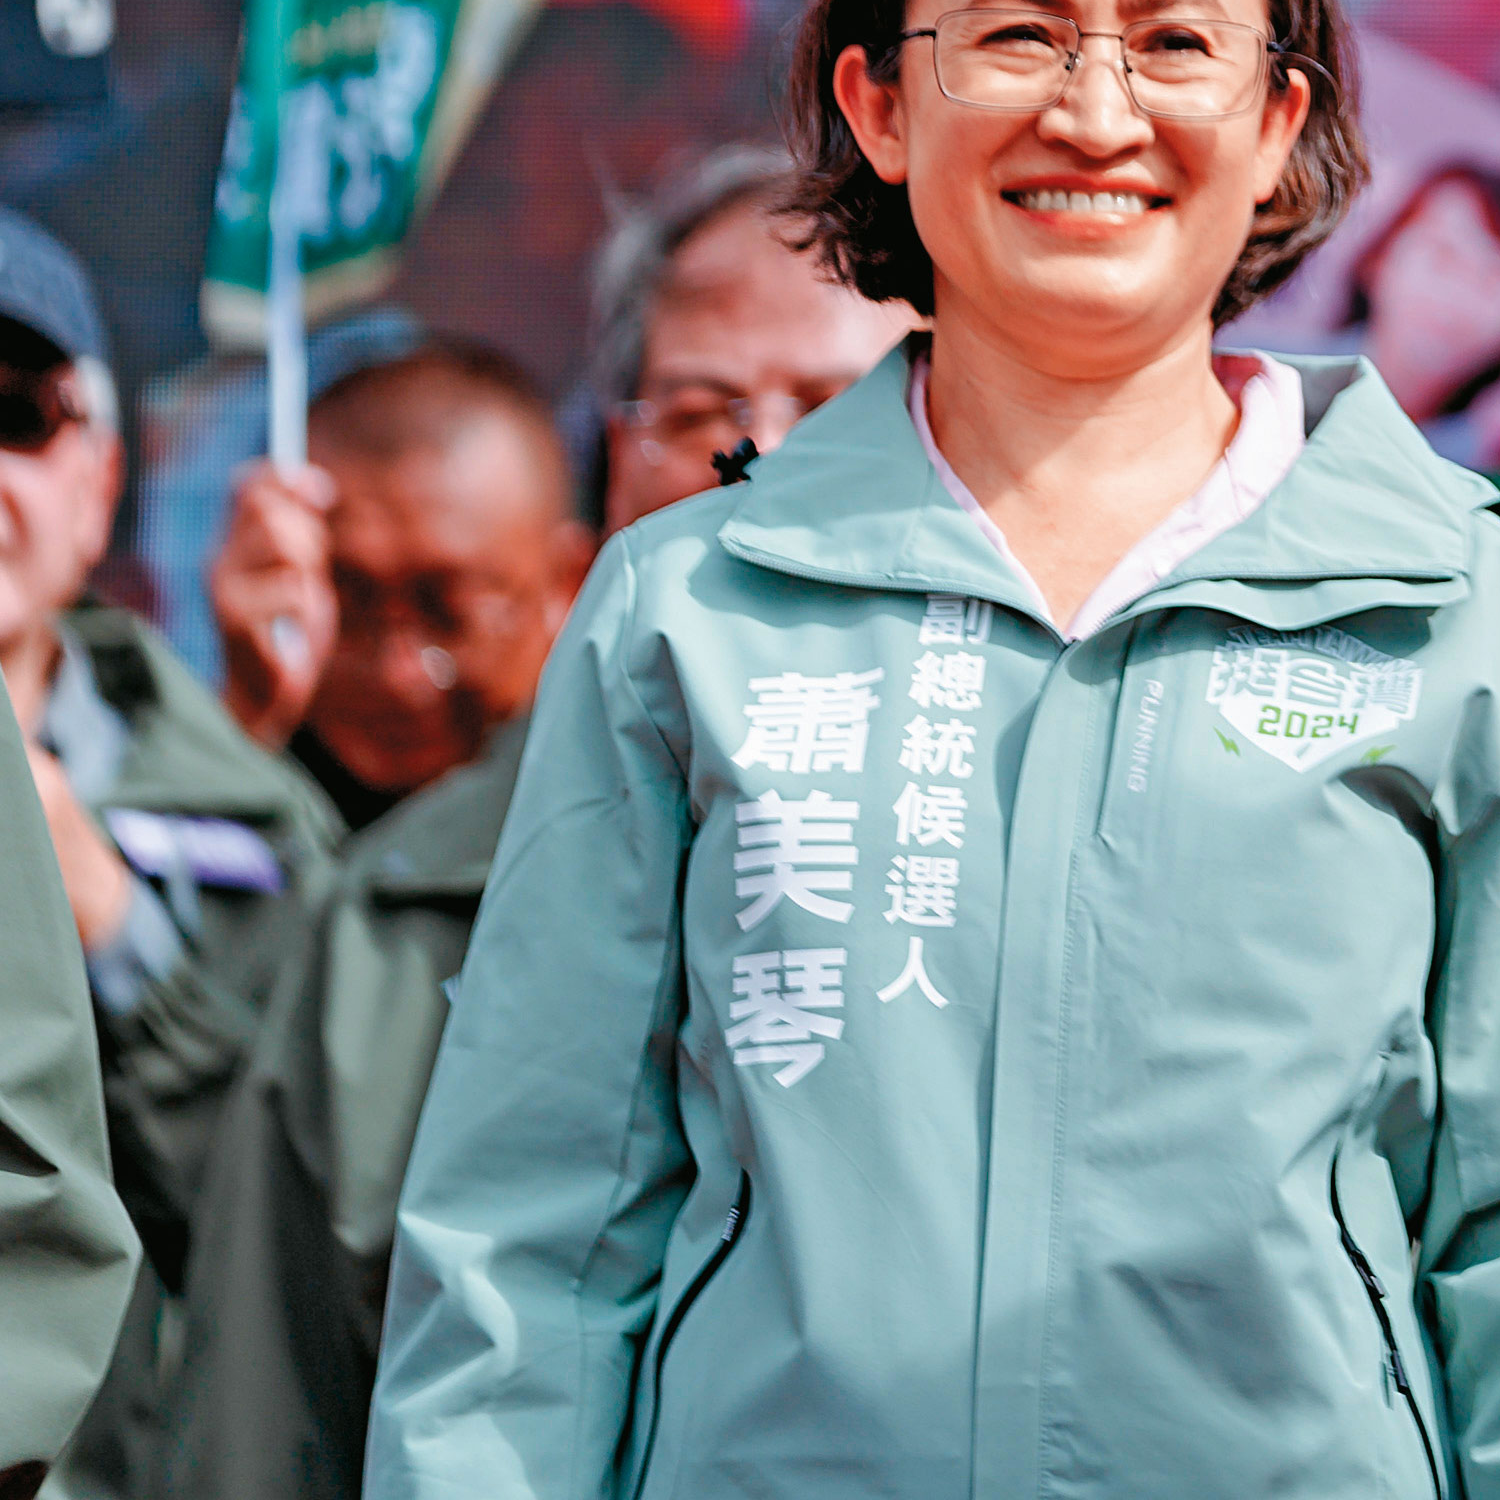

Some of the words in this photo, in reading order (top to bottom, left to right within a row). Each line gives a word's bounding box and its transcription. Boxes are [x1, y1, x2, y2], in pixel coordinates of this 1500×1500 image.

[725, 666, 886, 1089] 蕭美琴
[876, 593, 993, 1010] 副總統候選人
[1256, 704, 1359, 739] 2024
